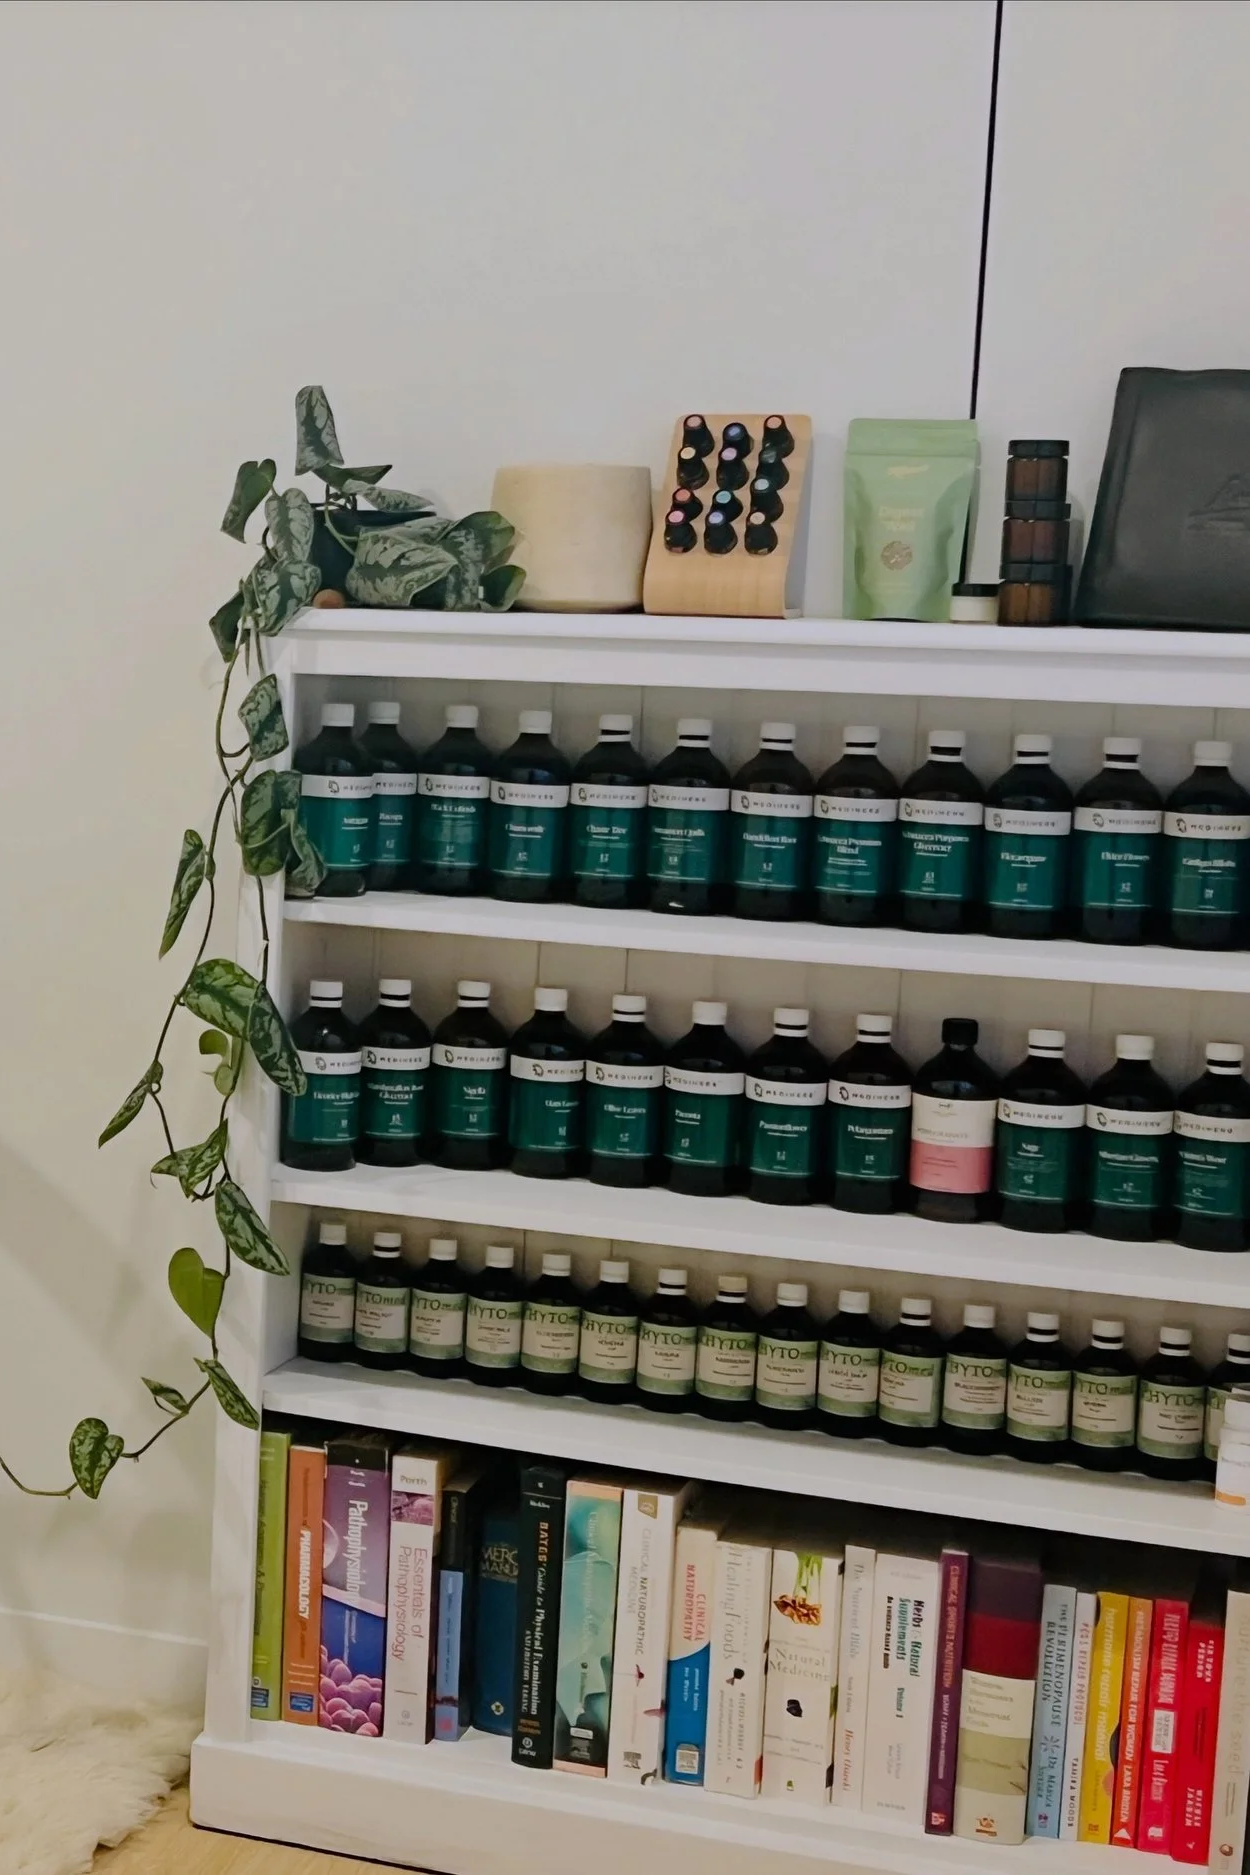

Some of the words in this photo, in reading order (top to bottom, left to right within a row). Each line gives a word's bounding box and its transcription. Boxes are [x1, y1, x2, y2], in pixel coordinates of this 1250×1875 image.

[298, 1529, 312, 1620] PHARMACOLOGY
[482, 1546, 518, 1566] MERC
[639, 1528, 652, 1573] CLINICAL
[391, 1545, 413, 1662] Pathophysiology
[412, 1547, 429, 1618] Essentials
[626, 1566, 638, 1615] MEDICINE
[682, 1563, 696, 1641] NATUROPATHY
[411, 1623, 425, 1639] of
[531, 1608, 546, 1650] Physical
[634, 1576, 649, 1656] NATUROPATHIC
[694, 1593, 707, 1641] CLINICAL
[912, 1599, 925, 1628] Herbs
[1103, 1607, 1117, 1666] hormone
[769, 1660, 830, 1682] Medicine
[774, 1648, 826, 1667] Natural
[909, 1640, 923, 1677] Natural
[1041, 1621, 1056, 1701] REVOLUTION
[1050, 1624, 1068, 1727] PERIMENOPAUSE
[529, 1652, 544, 1716] Examination
[1097, 1669, 1112, 1707] repair
[1094, 1711, 1108, 1762] manual
[1124, 1724, 1136, 1761] WOMEN
[1227, 1731, 1245, 1776] seed
